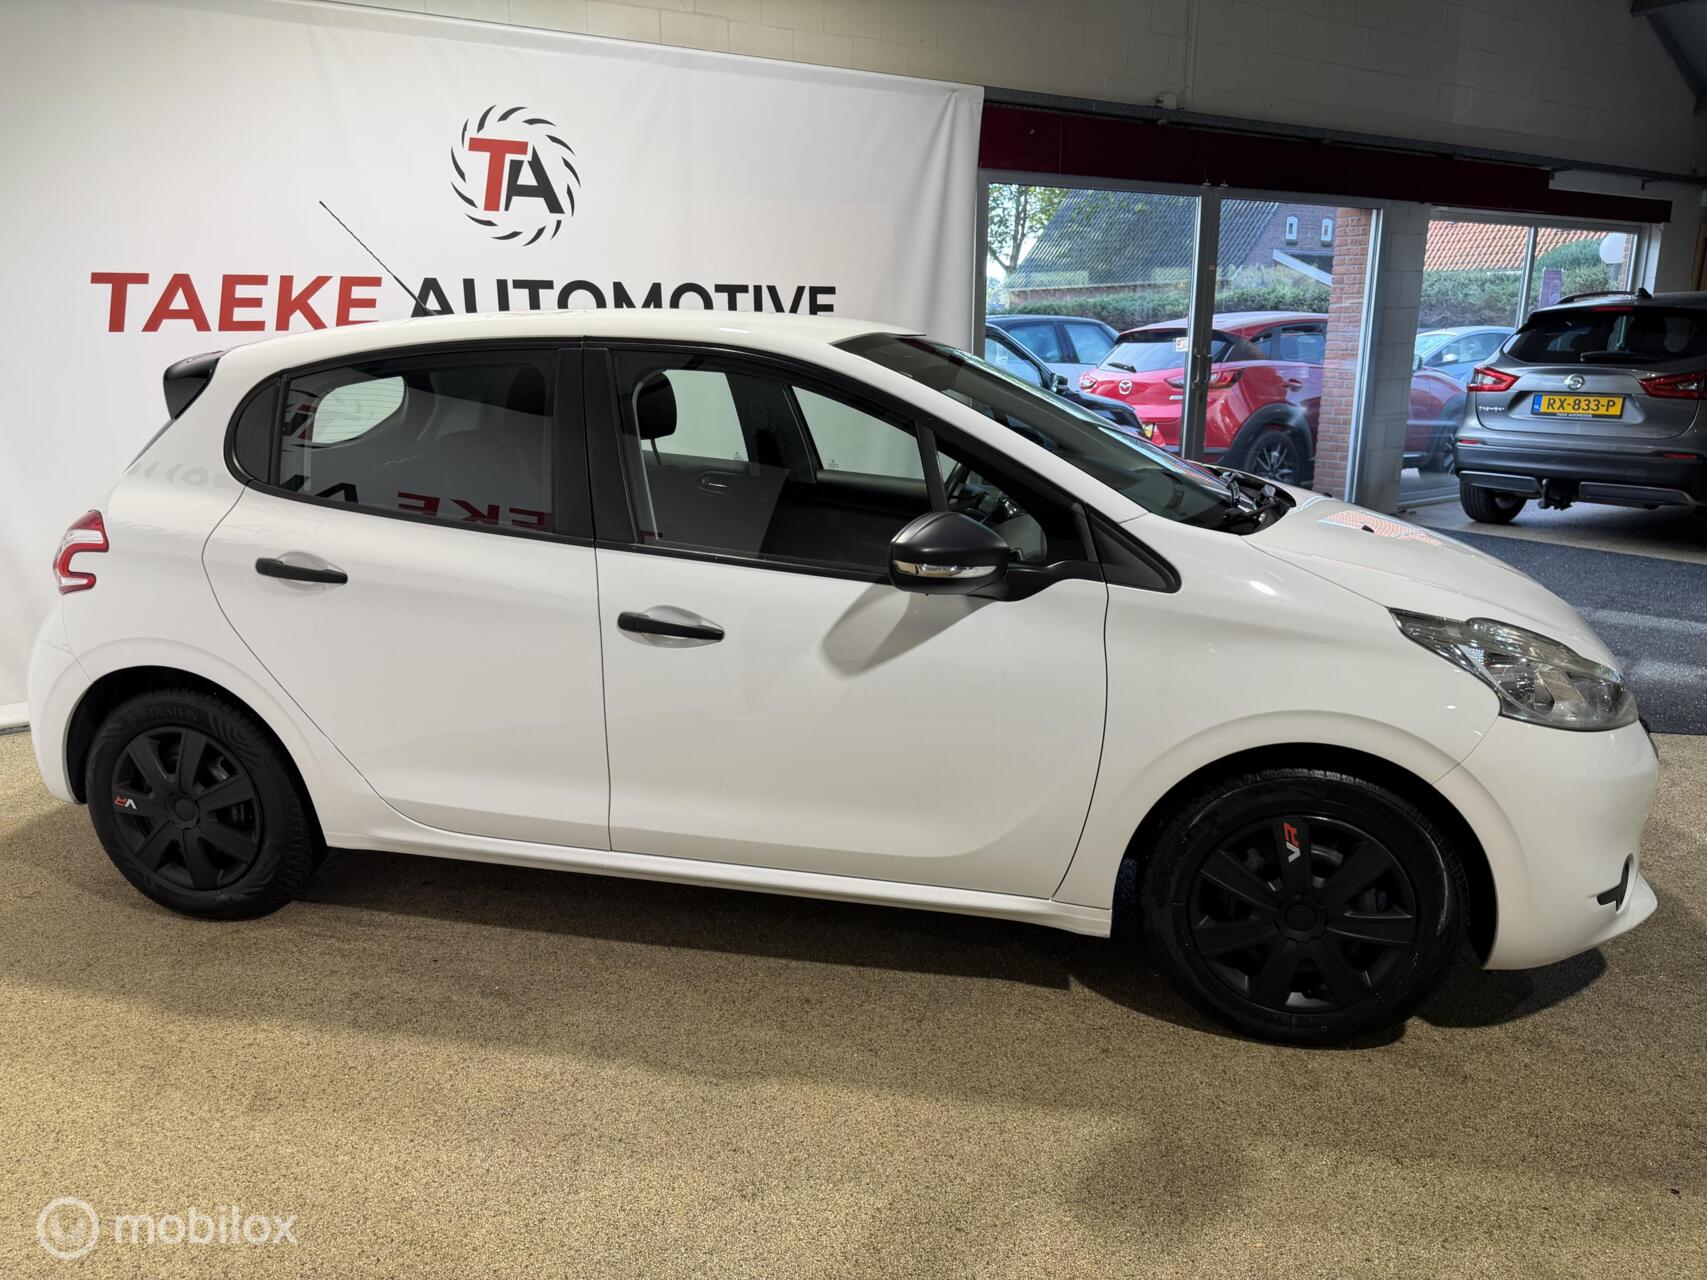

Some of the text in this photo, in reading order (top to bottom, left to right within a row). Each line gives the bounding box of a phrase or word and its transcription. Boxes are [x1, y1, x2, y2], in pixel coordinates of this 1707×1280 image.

[468, 137, 566, 215] TA
[90, 272, 382, 332] TAEKE
[1546, 397, 1616, 412] RX-833-P
